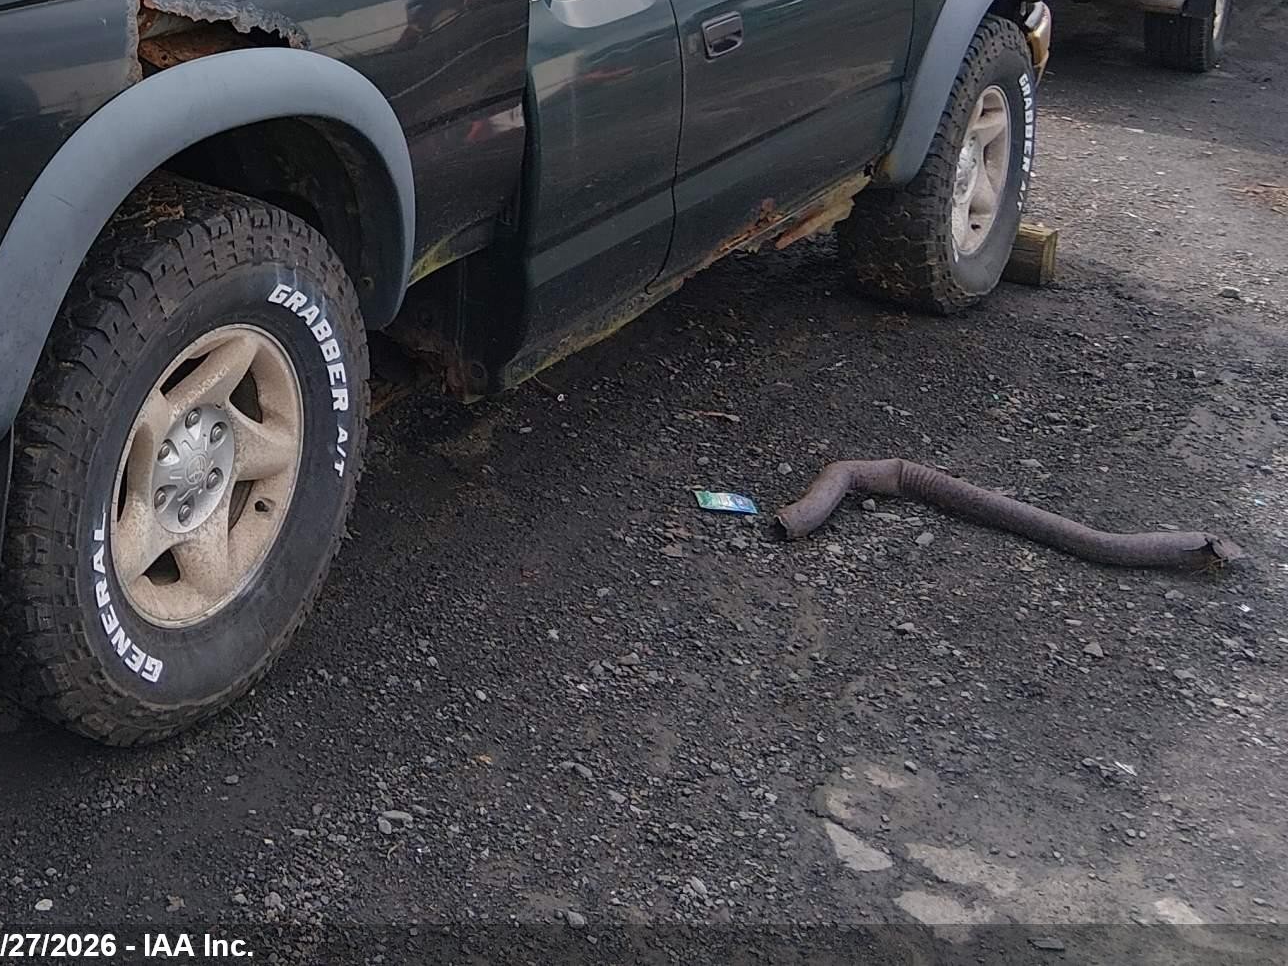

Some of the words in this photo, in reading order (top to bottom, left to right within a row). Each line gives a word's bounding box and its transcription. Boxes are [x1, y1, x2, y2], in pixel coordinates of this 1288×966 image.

[267, 283, 349, 412] GRABBER
[333, 424, 349, 478] A/T
[93, 511, 163, 684] GENERAL
